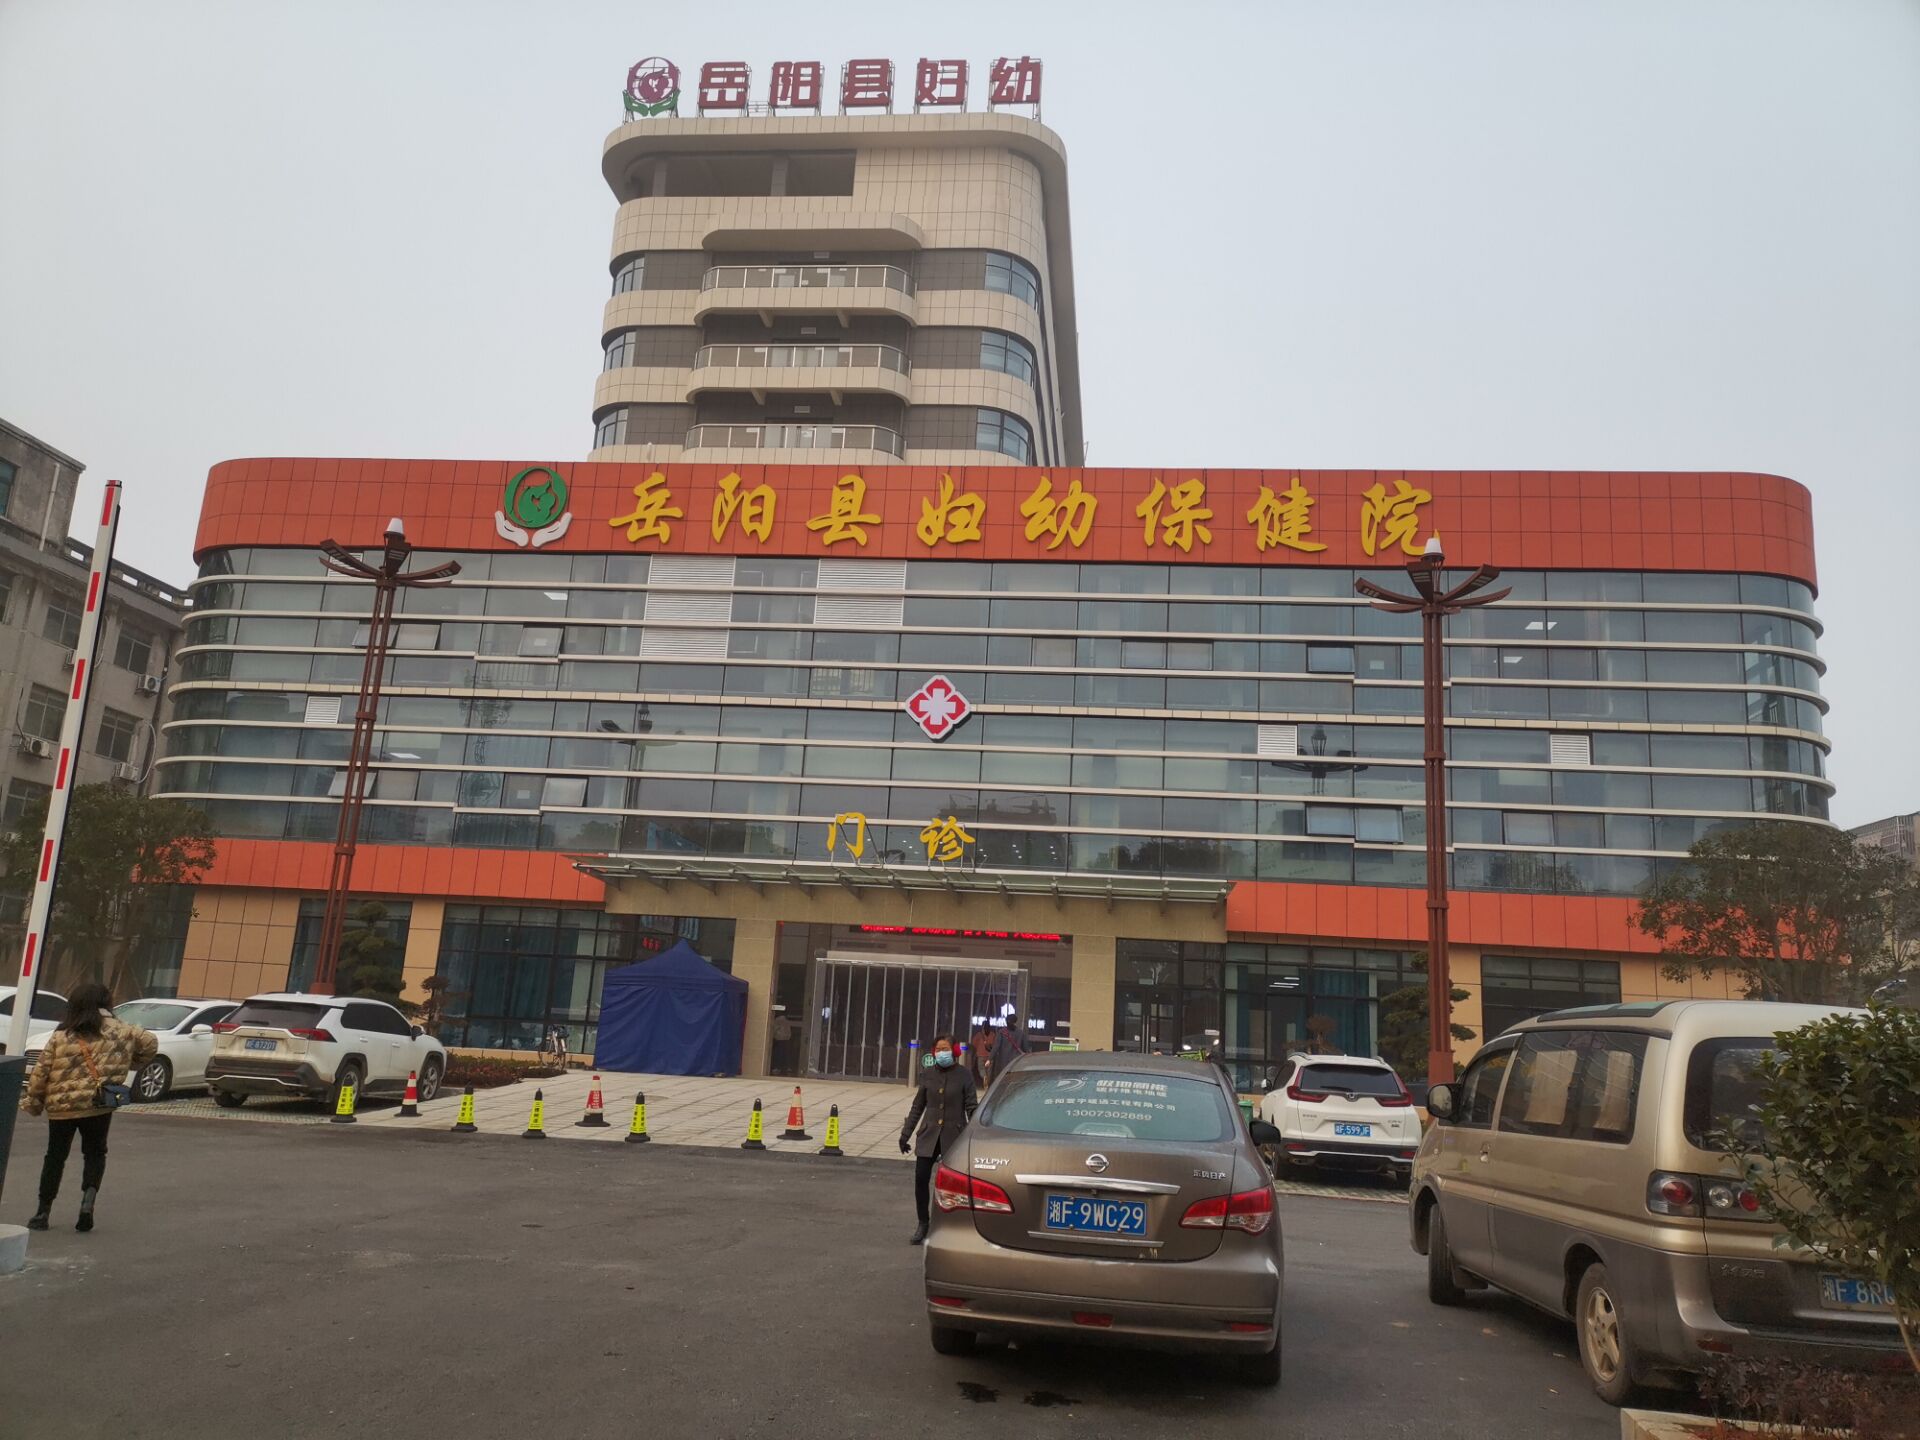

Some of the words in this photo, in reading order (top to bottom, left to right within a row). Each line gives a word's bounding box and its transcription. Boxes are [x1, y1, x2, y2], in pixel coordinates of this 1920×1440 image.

[698, 56, 1042, 110] 岳阳县妇幼
[608, 473, 1438, 556] 岳阳县妇幼保健院
[827, 812, 976, 862] 门诊
[974, 1157, 1011, 1166] SYLPHY
